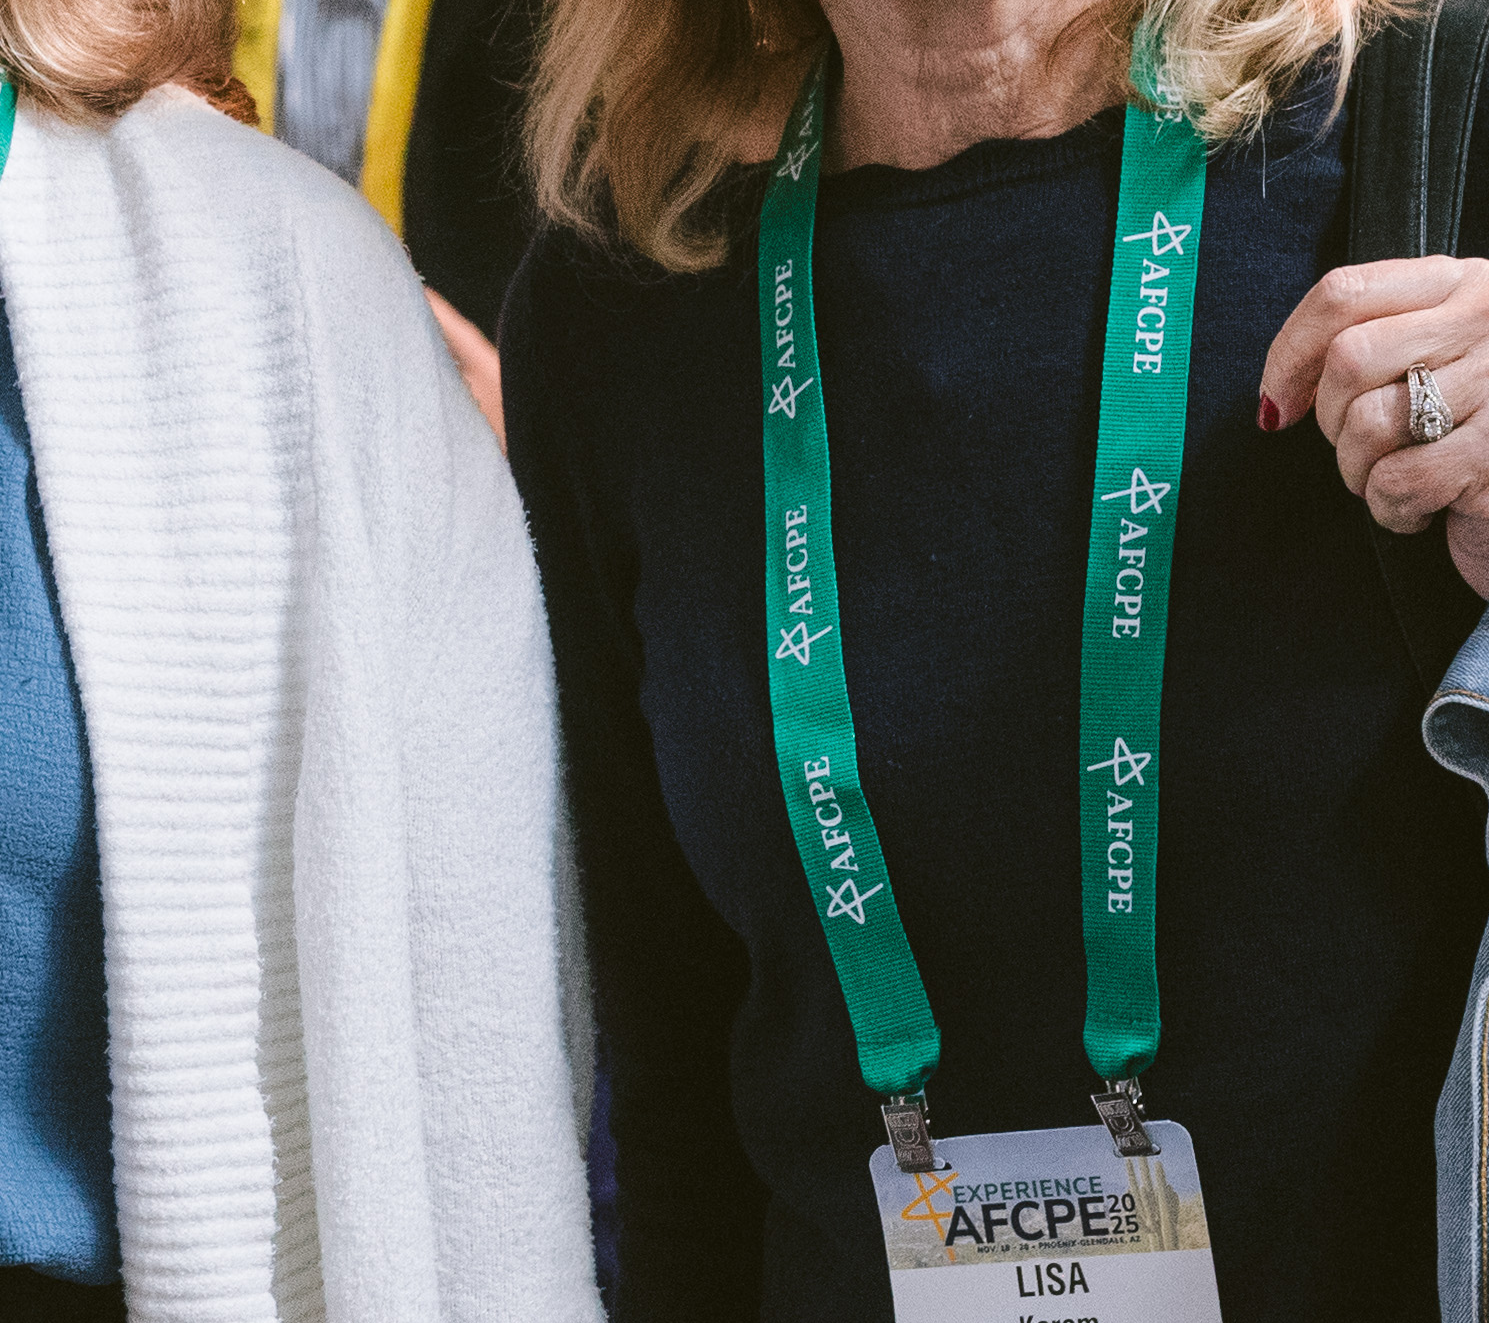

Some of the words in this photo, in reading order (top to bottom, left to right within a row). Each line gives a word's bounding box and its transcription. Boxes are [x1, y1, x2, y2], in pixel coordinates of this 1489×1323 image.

[775, 259, 797, 368] AFCPE
[1132, 258, 1170, 375] AFCPE
[785, 504, 814, 615] AFCPE
[1112, 518, 1148, 639] AFCPE
[803, 756, 859, 873] AFCPE
[1106, 789, 1133, 914] AFCPE
[944, 1196, 1110, 1247] AFCPE
[1108, 1193, 1136, 1215] 20
[953, 1176, 1104, 1204] EXPERIENCE
[1111, 1215, 1140, 1236] 25
[1016, 1262, 1090, 1298] LISA
